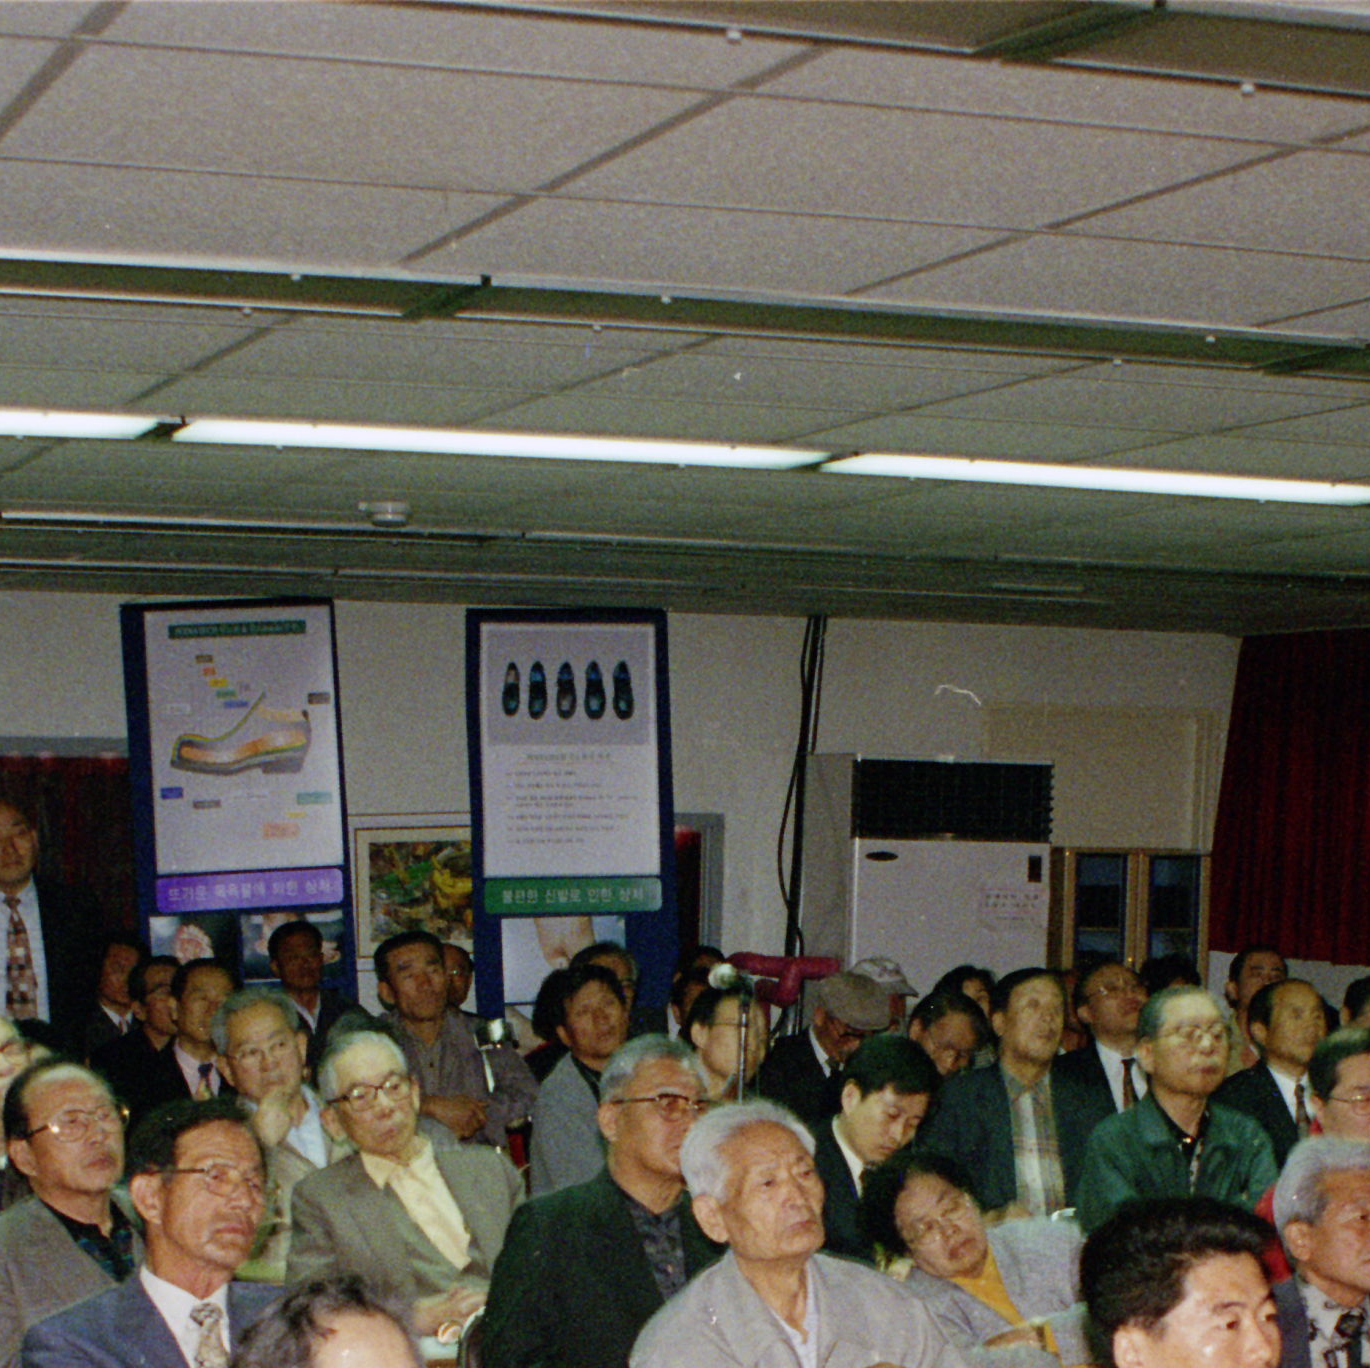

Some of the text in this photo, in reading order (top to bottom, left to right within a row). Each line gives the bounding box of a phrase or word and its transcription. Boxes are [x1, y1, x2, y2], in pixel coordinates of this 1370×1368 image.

[502, 889, 538, 904] 불편한
[546, 888, 582, 904] 신발로
[587, 887, 612, 903] 인한
